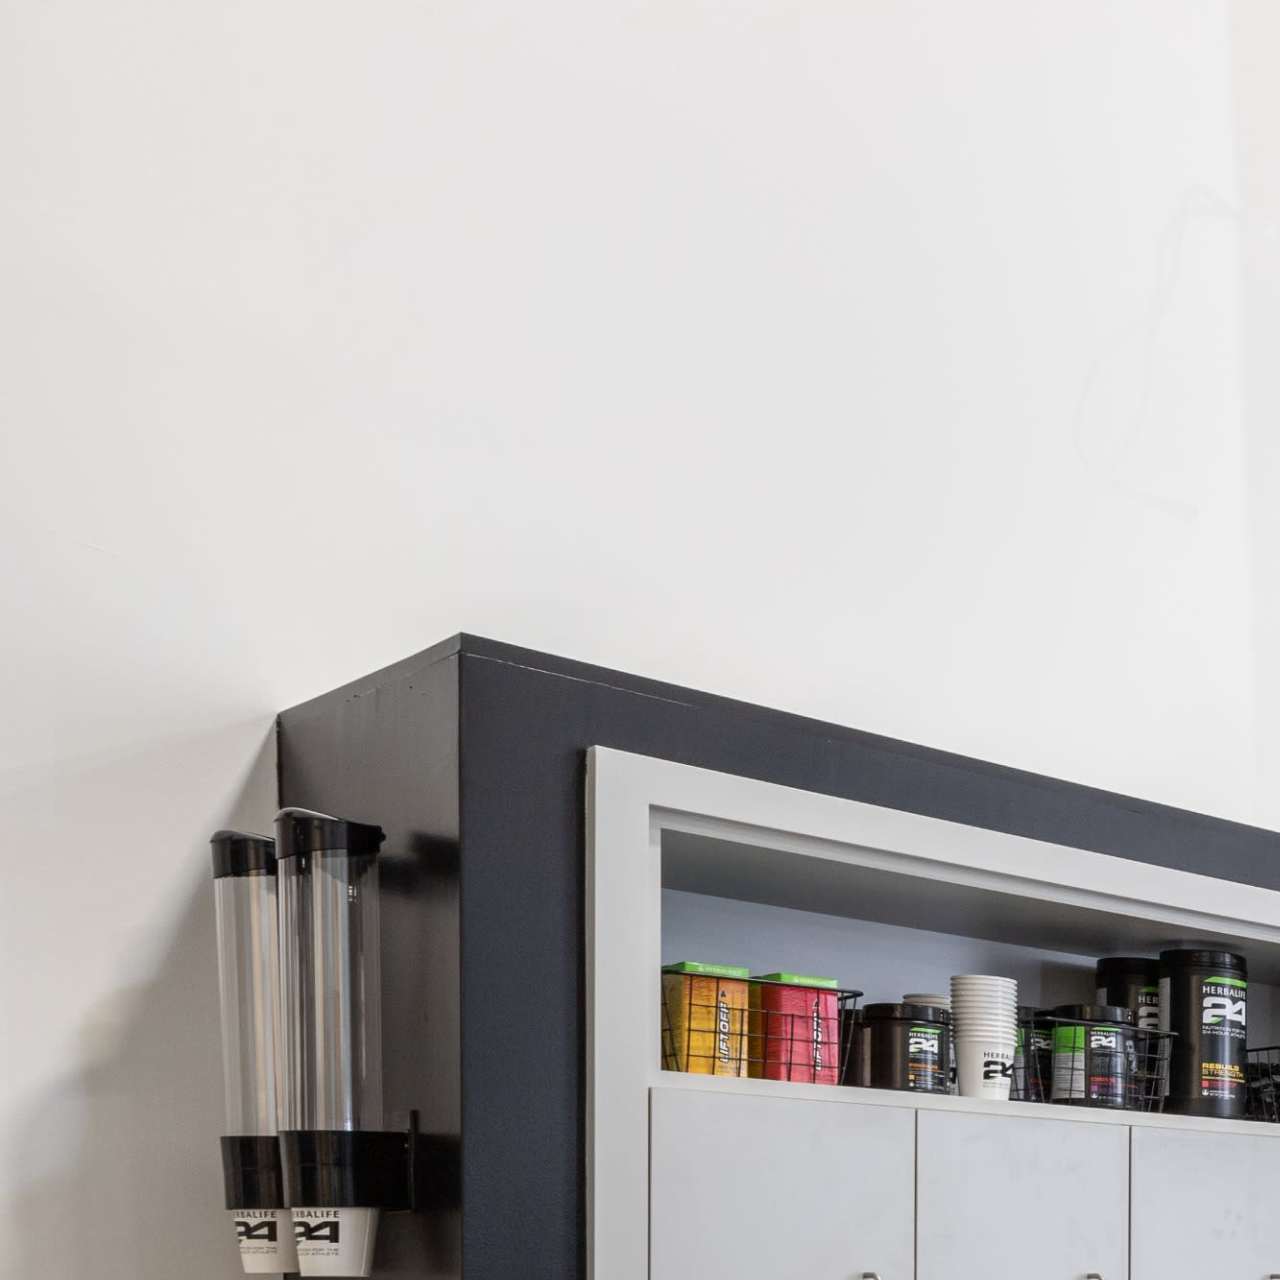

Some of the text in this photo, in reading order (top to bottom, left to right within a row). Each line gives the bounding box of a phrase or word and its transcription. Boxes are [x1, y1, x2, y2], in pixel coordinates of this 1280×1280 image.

[1202, 996, 1246, 1026] 24
[909, 1038, 938, 1053] 24
[1090, 1036, 1117, 1049] 24
[1202, 1062, 1240, 1072] REBUILD
